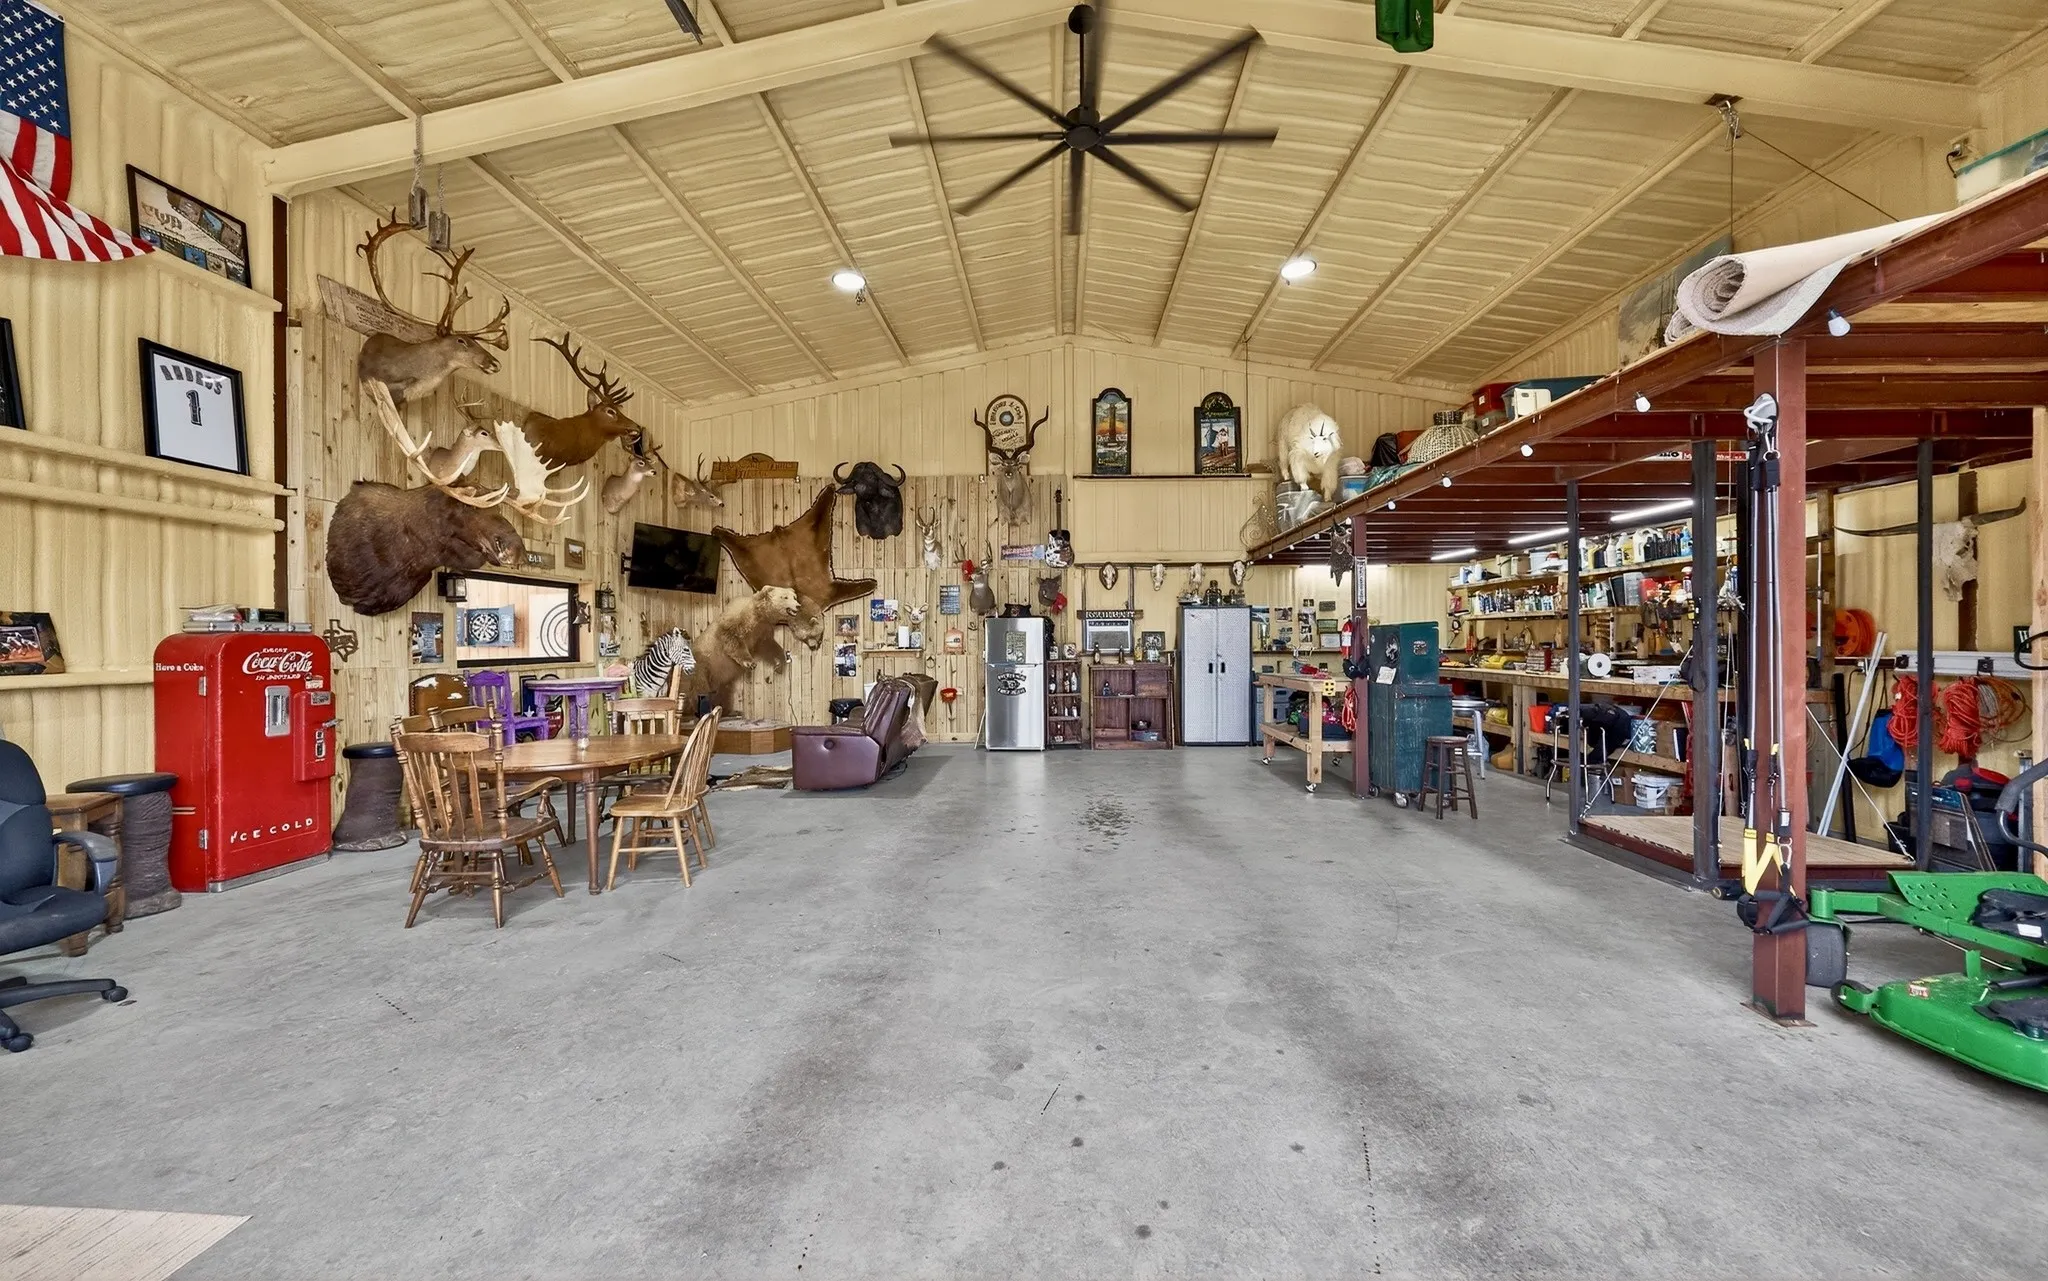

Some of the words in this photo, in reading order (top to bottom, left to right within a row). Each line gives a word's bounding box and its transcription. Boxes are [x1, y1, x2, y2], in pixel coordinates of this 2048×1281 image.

[186, 390, 202, 426] 1
[155, 663, 175, 671] Have
[183, 663, 204, 671] Coke
[242, 651, 313, 675] Coca-Cola
[230, 829, 261, 844] ICE
[269, 817, 313, 835] COLD
